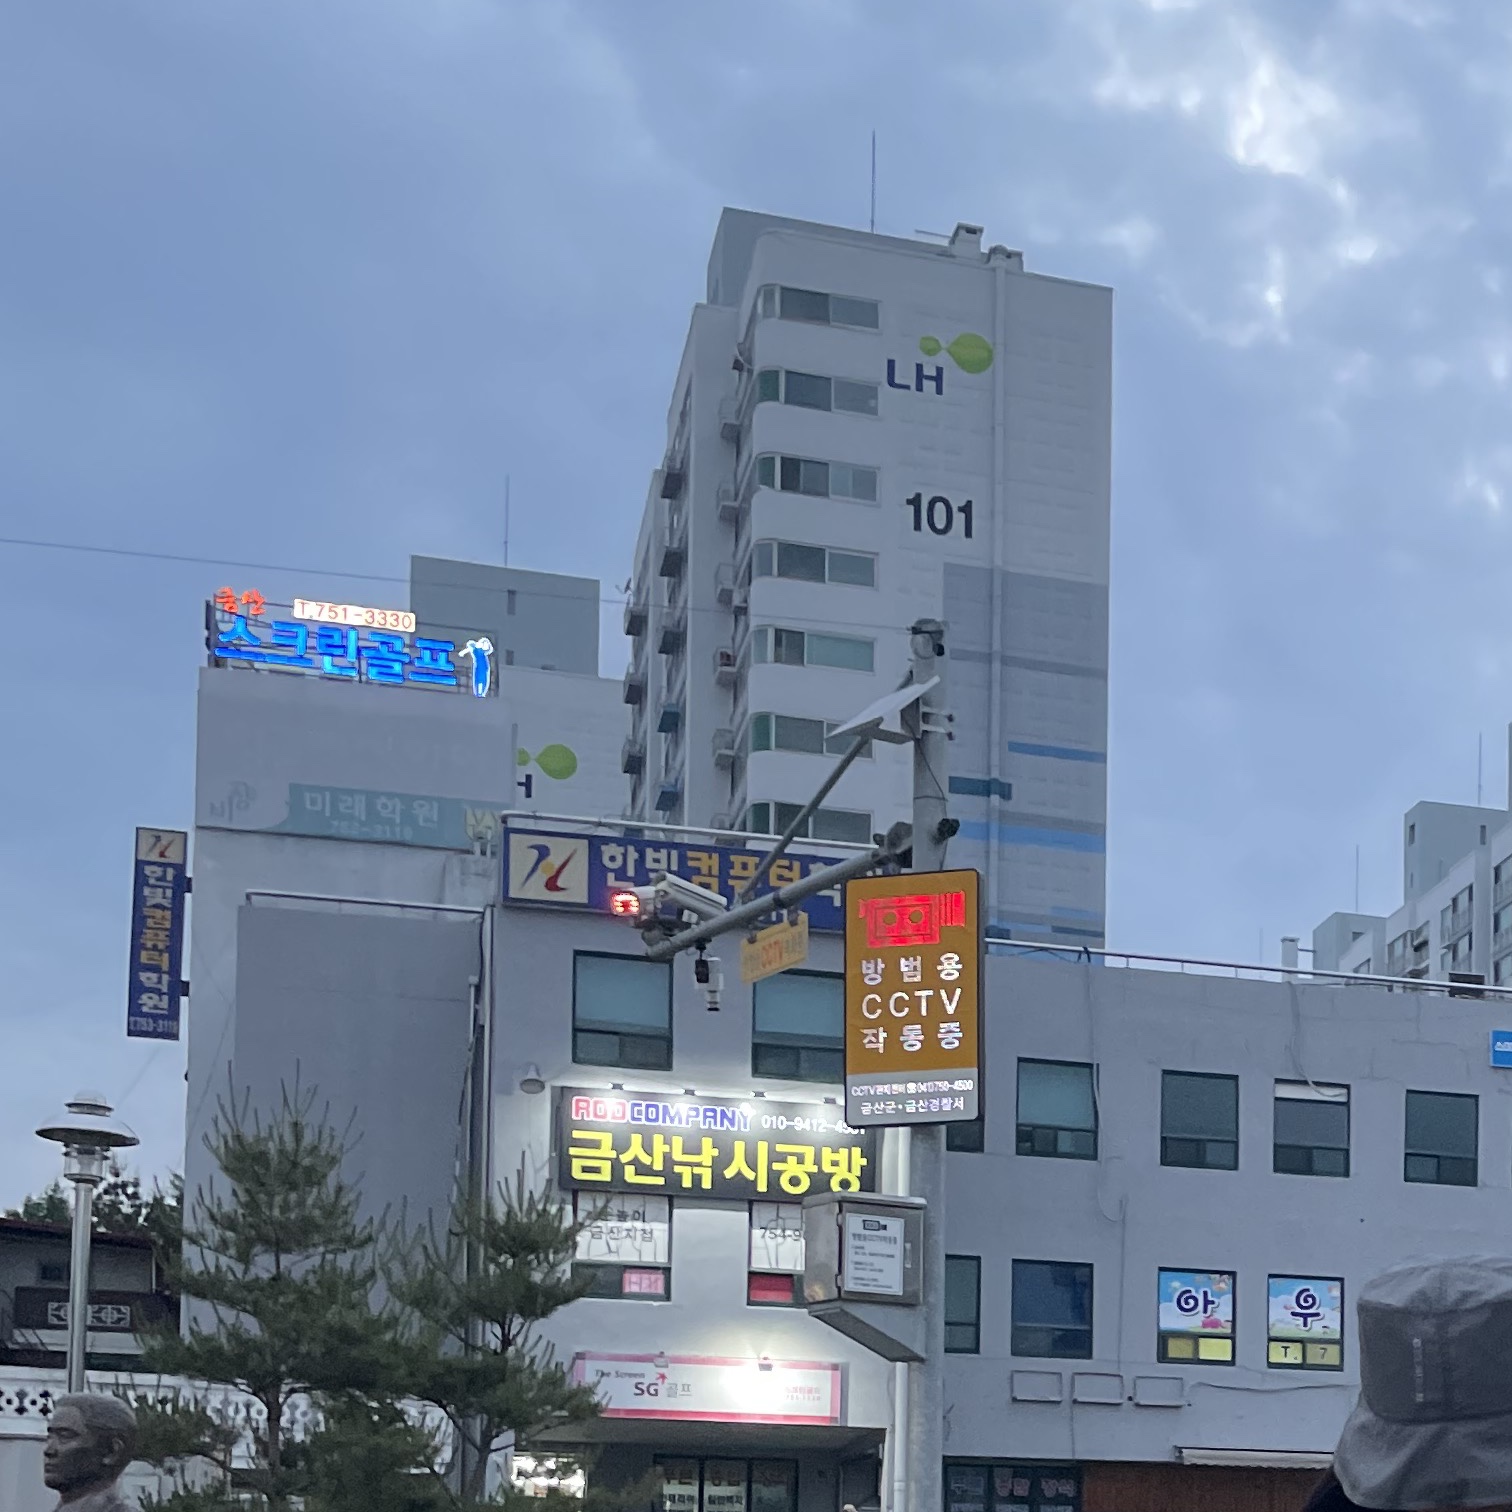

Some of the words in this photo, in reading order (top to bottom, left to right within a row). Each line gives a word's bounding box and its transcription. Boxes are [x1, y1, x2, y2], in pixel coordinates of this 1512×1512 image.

[887, 358, 944, 396] LH
[906, 492, 973, 539] 101
[214, 614, 458, 686] 스크린골프
[303, 791, 440, 828] 미래학원
[861, 952, 963, 986] 방범용
[861, 987, 962, 1020] CCTV
[861, 1021, 963, 1054] 작동중
[568, 1129, 868, 1195] 금산낚시공방
[1176, 1288, 1216, 1315] 아
[1290, 1287, 1321, 1329] 우
[633, 1381, 659, 1397] SG
